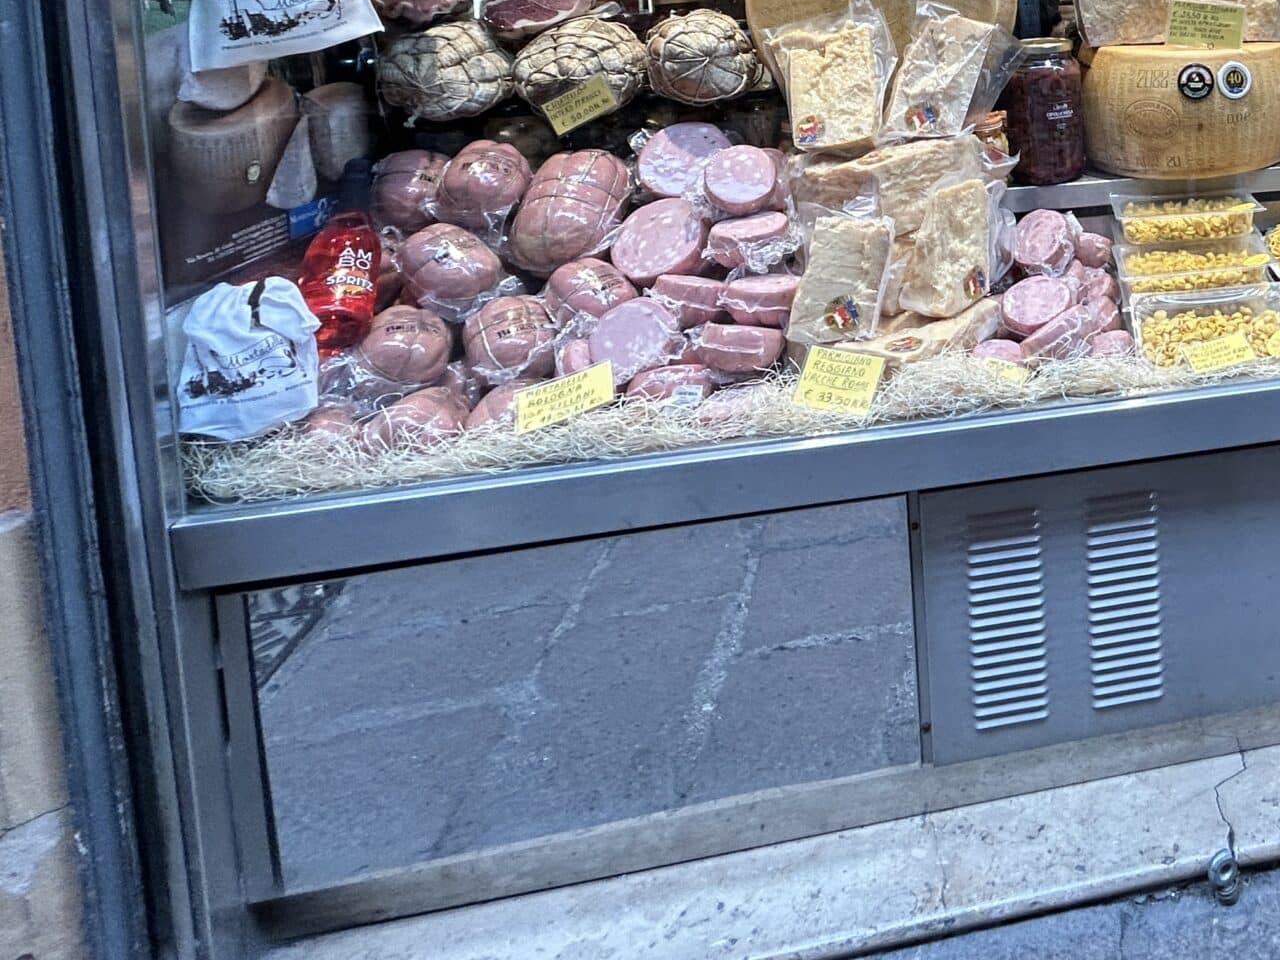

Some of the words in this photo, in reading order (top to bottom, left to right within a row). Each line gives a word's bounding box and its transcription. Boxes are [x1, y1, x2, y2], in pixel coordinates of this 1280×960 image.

[1227, 72, 1242, 85] 40
[338, 256, 370, 270] BO
[339, 247, 372, 261] AM
[325, 275, 374, 292] SPRITZ
[817, 348, 872, 367] PARMIGIANO
[812, 360, 867, 378] REGGIANO
[525, 372, 589, 399] MORTADELLA
[527, 383, 583, 409] BOLOGNA
[550, 388, 596, 411] VILLANI
